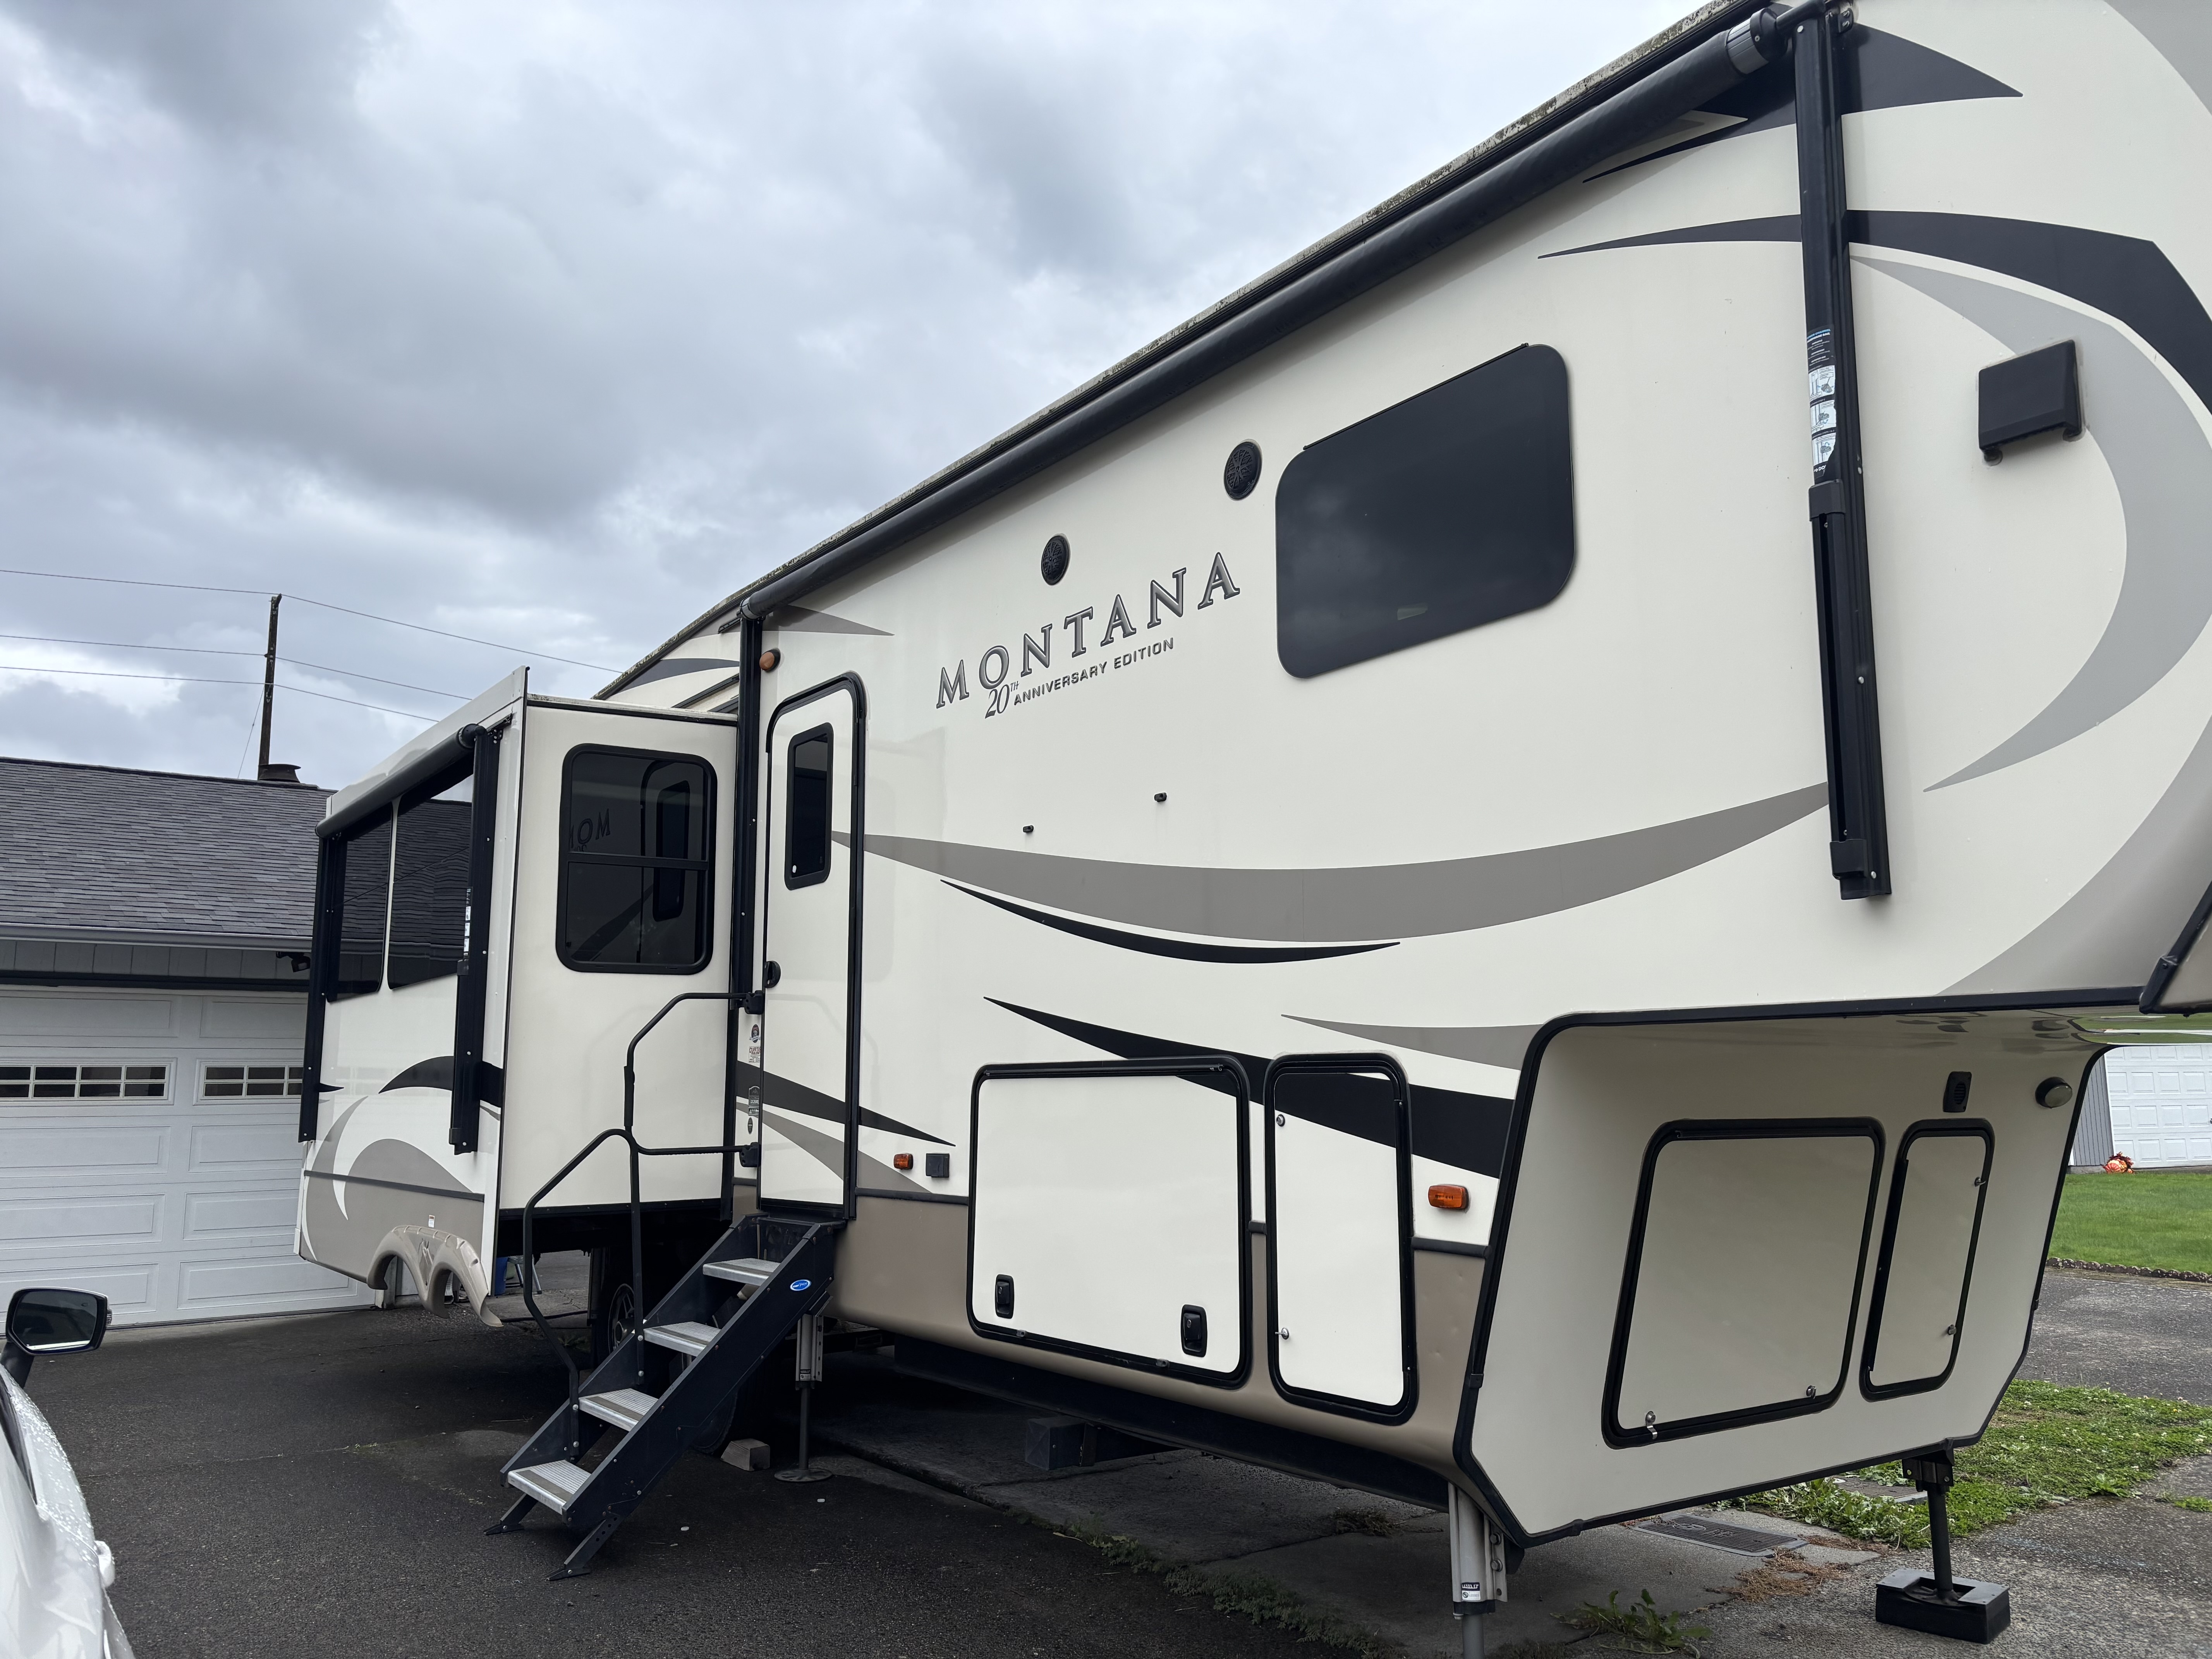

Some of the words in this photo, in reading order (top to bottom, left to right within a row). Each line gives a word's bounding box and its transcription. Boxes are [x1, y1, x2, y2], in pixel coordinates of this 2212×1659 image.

[936, 551, 1240, 709] MONTANA
[985, 681, 1019, 719] 20TH
[1014, 661, 1107, 706] ANNIVERSARY
[1114, 637, 1174, 669] EDITION
